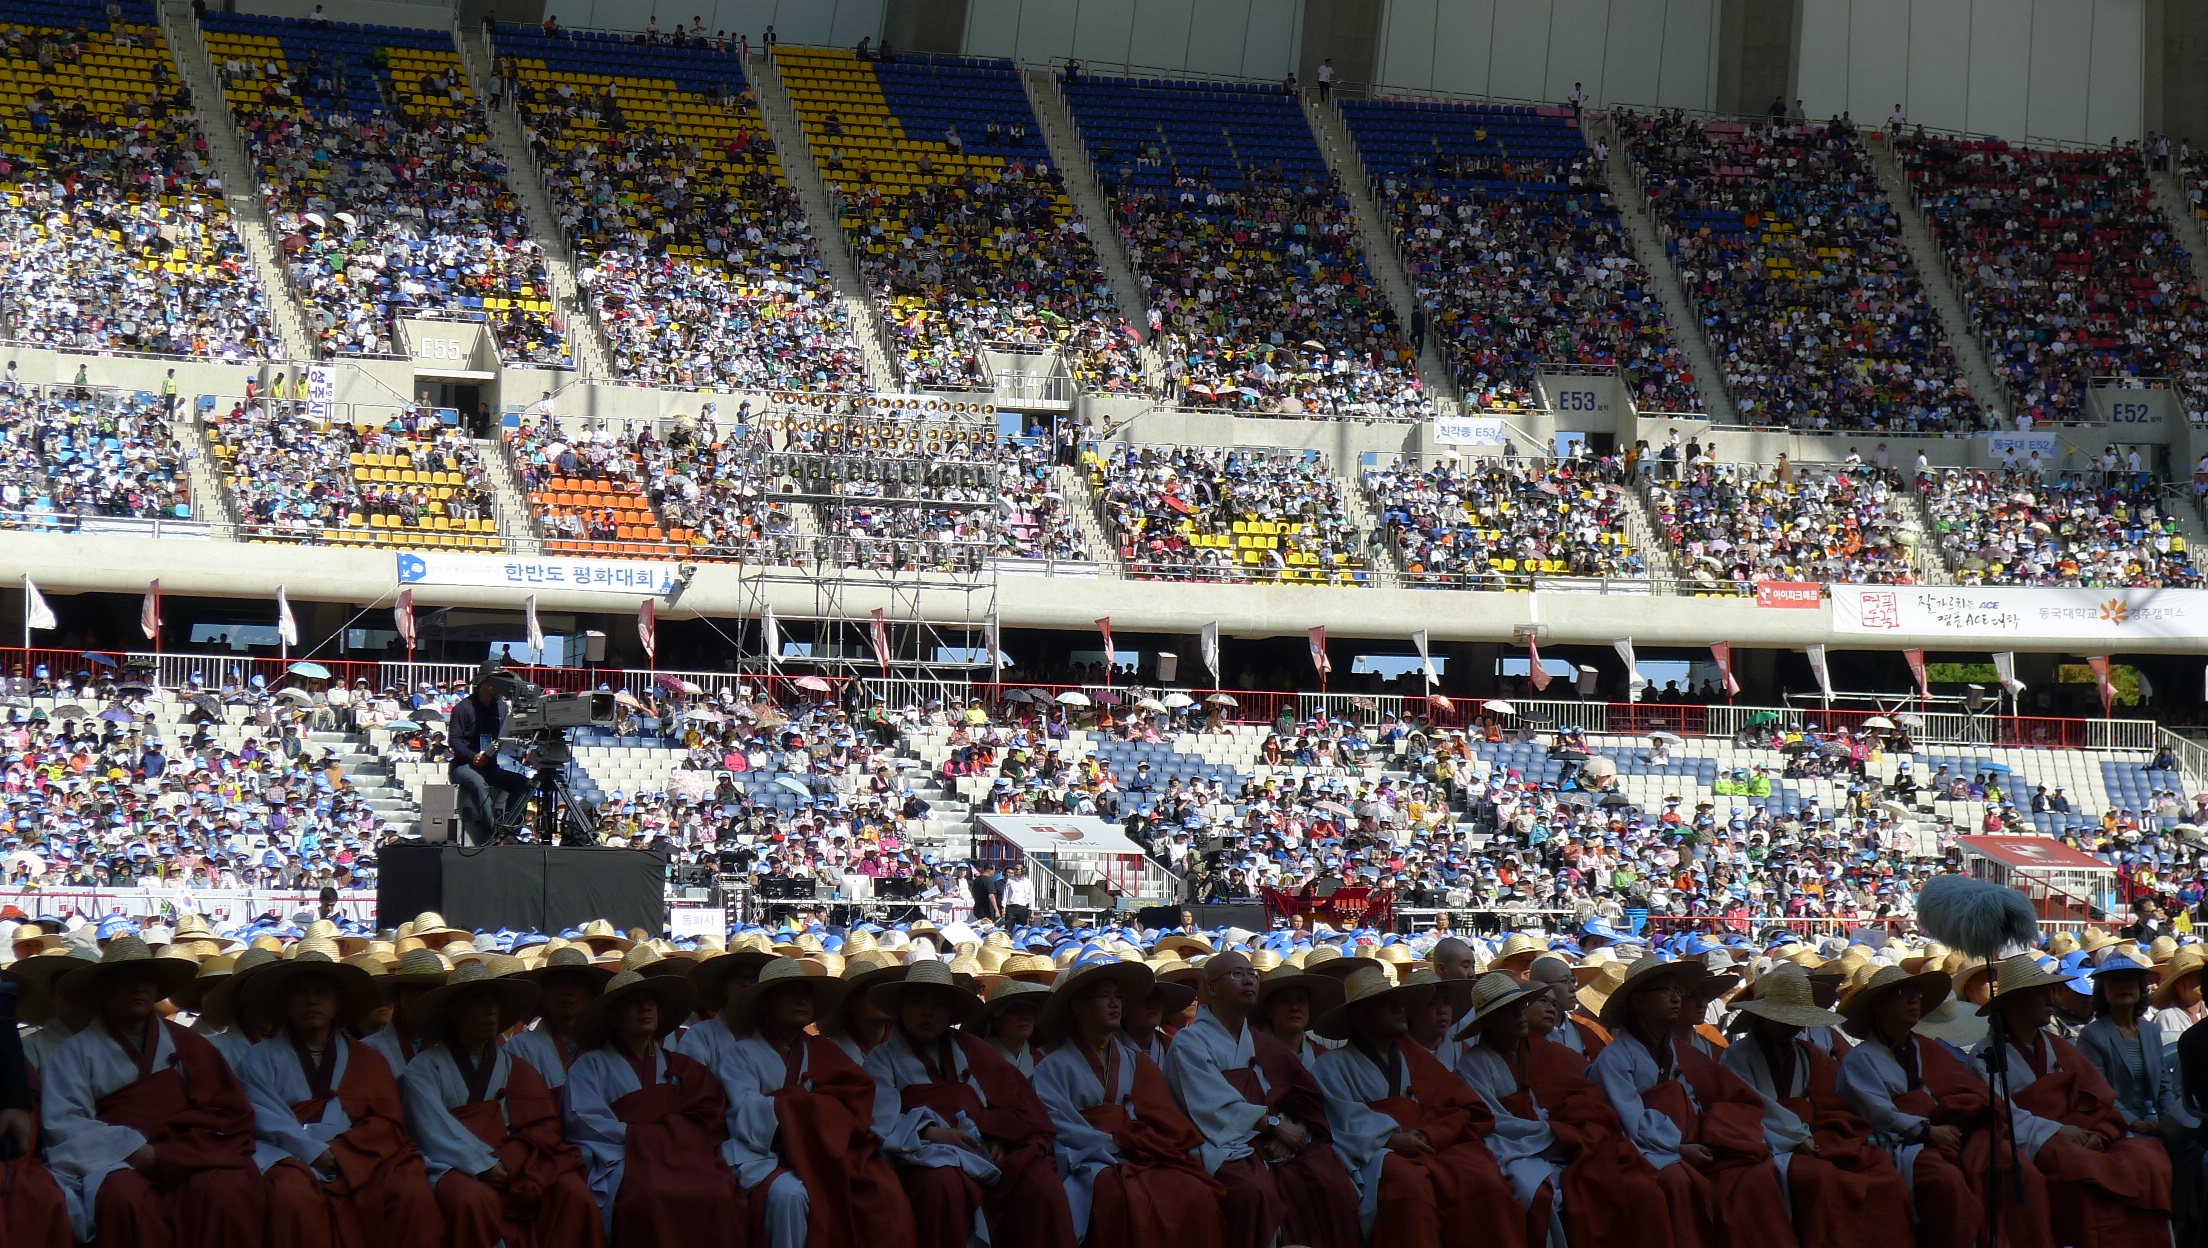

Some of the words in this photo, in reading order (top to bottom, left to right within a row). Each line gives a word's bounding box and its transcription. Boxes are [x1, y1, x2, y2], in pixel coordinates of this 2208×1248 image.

[420, 337, 460, 360] E55
[1000, 368, 1039, 390] E54
[1560, 391, 1596, 411] E53
[2113, 403, 2149, 423] E52
[1440, 425, 1471, 438] 진각종
[1475, 427, 1495, 437] E53
[1993, 438, 2025, 451] 동국대
[2029, 440, 2049, 450] E52
[504, 563, 565, 583] 한반도
[573, 566, 654, 588] 평화대회
[1979, 601, 1999, 610] ACE
[2038, 607, 2098, 620] 동국대학교
[2130, 607, 2185, 621] 경주캠퍼스
[682, 914, 715, 926] 동화사
